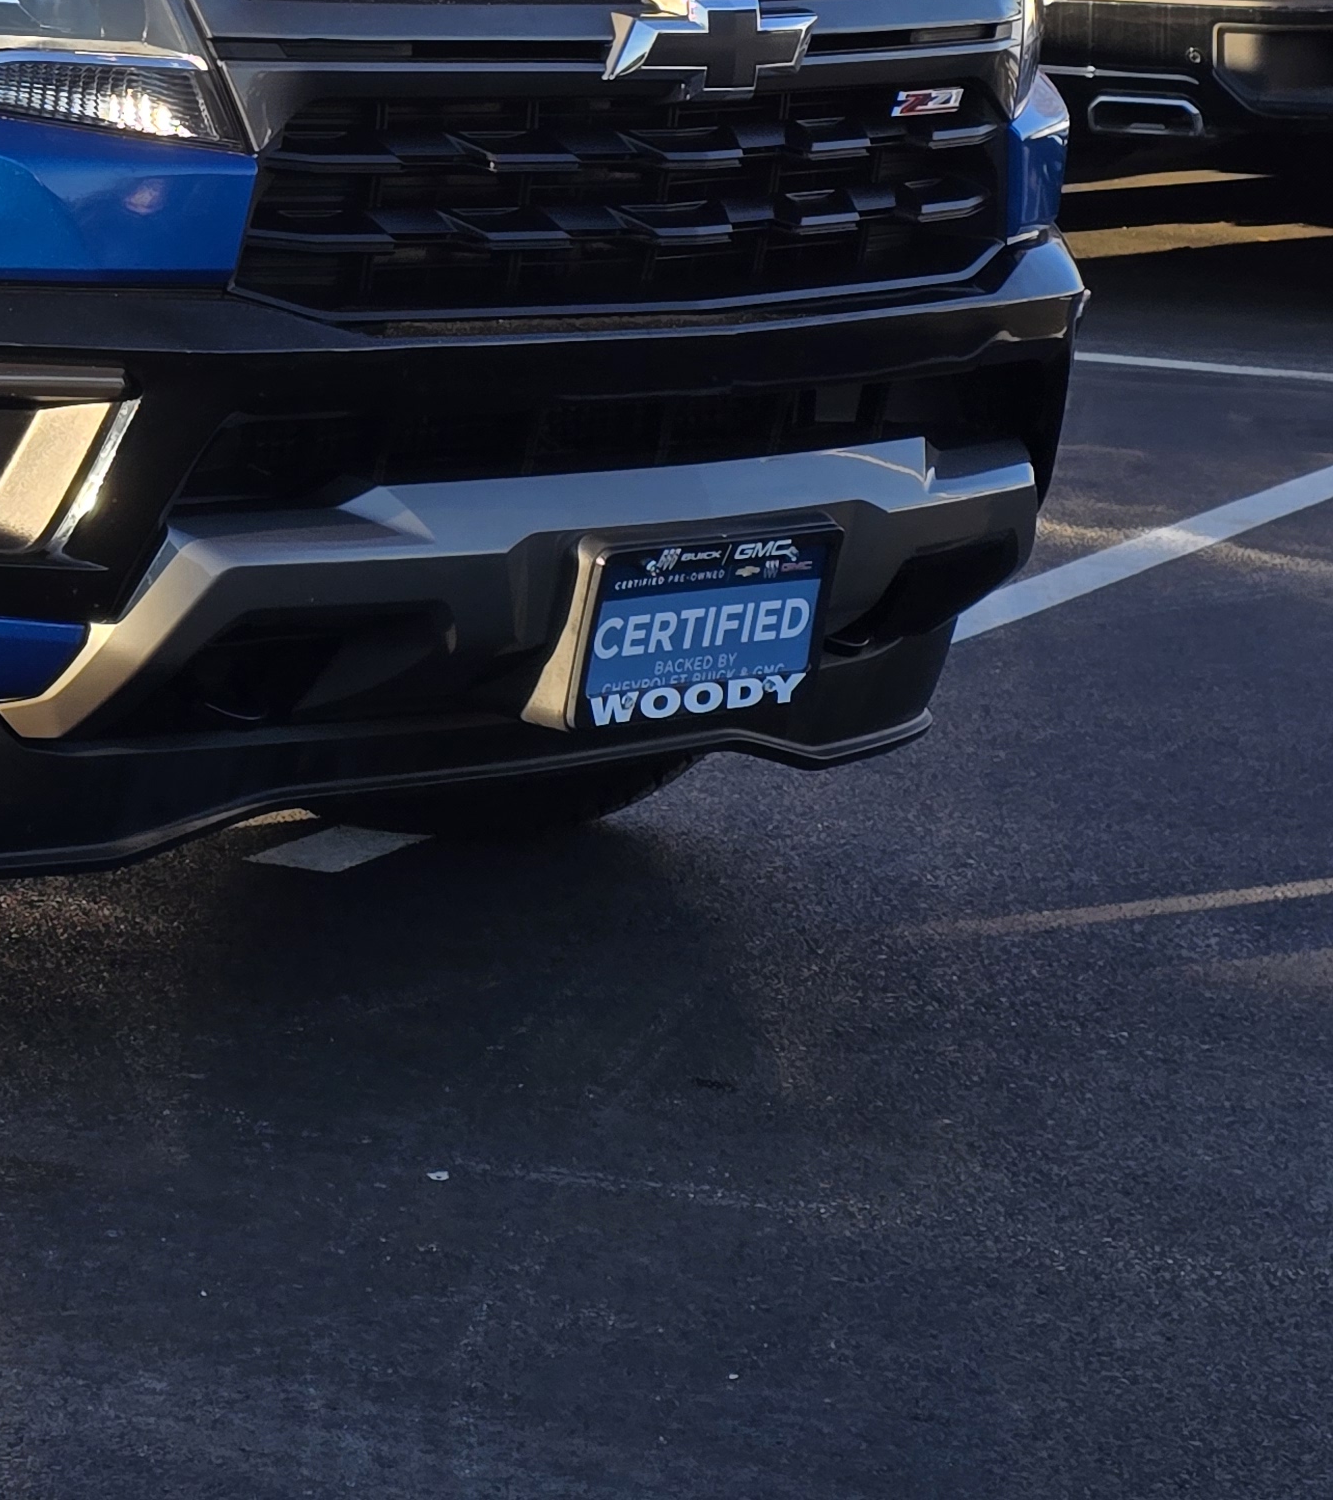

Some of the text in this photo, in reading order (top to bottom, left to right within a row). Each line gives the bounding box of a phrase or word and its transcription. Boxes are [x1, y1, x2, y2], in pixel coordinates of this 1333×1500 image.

[891, 87, 964, 117] Z71
[681, 539, 794, 561] BUICK GMC
[781, 561, 812, 572] GMC
[615, 569, 725, 591] CERTIFIED PRE-OWNED
[594, 598, 810, 660] CERTIFIED
[654, 653, 737, 675] BACKED BY
[590, 672, 806, 726] WOODY
